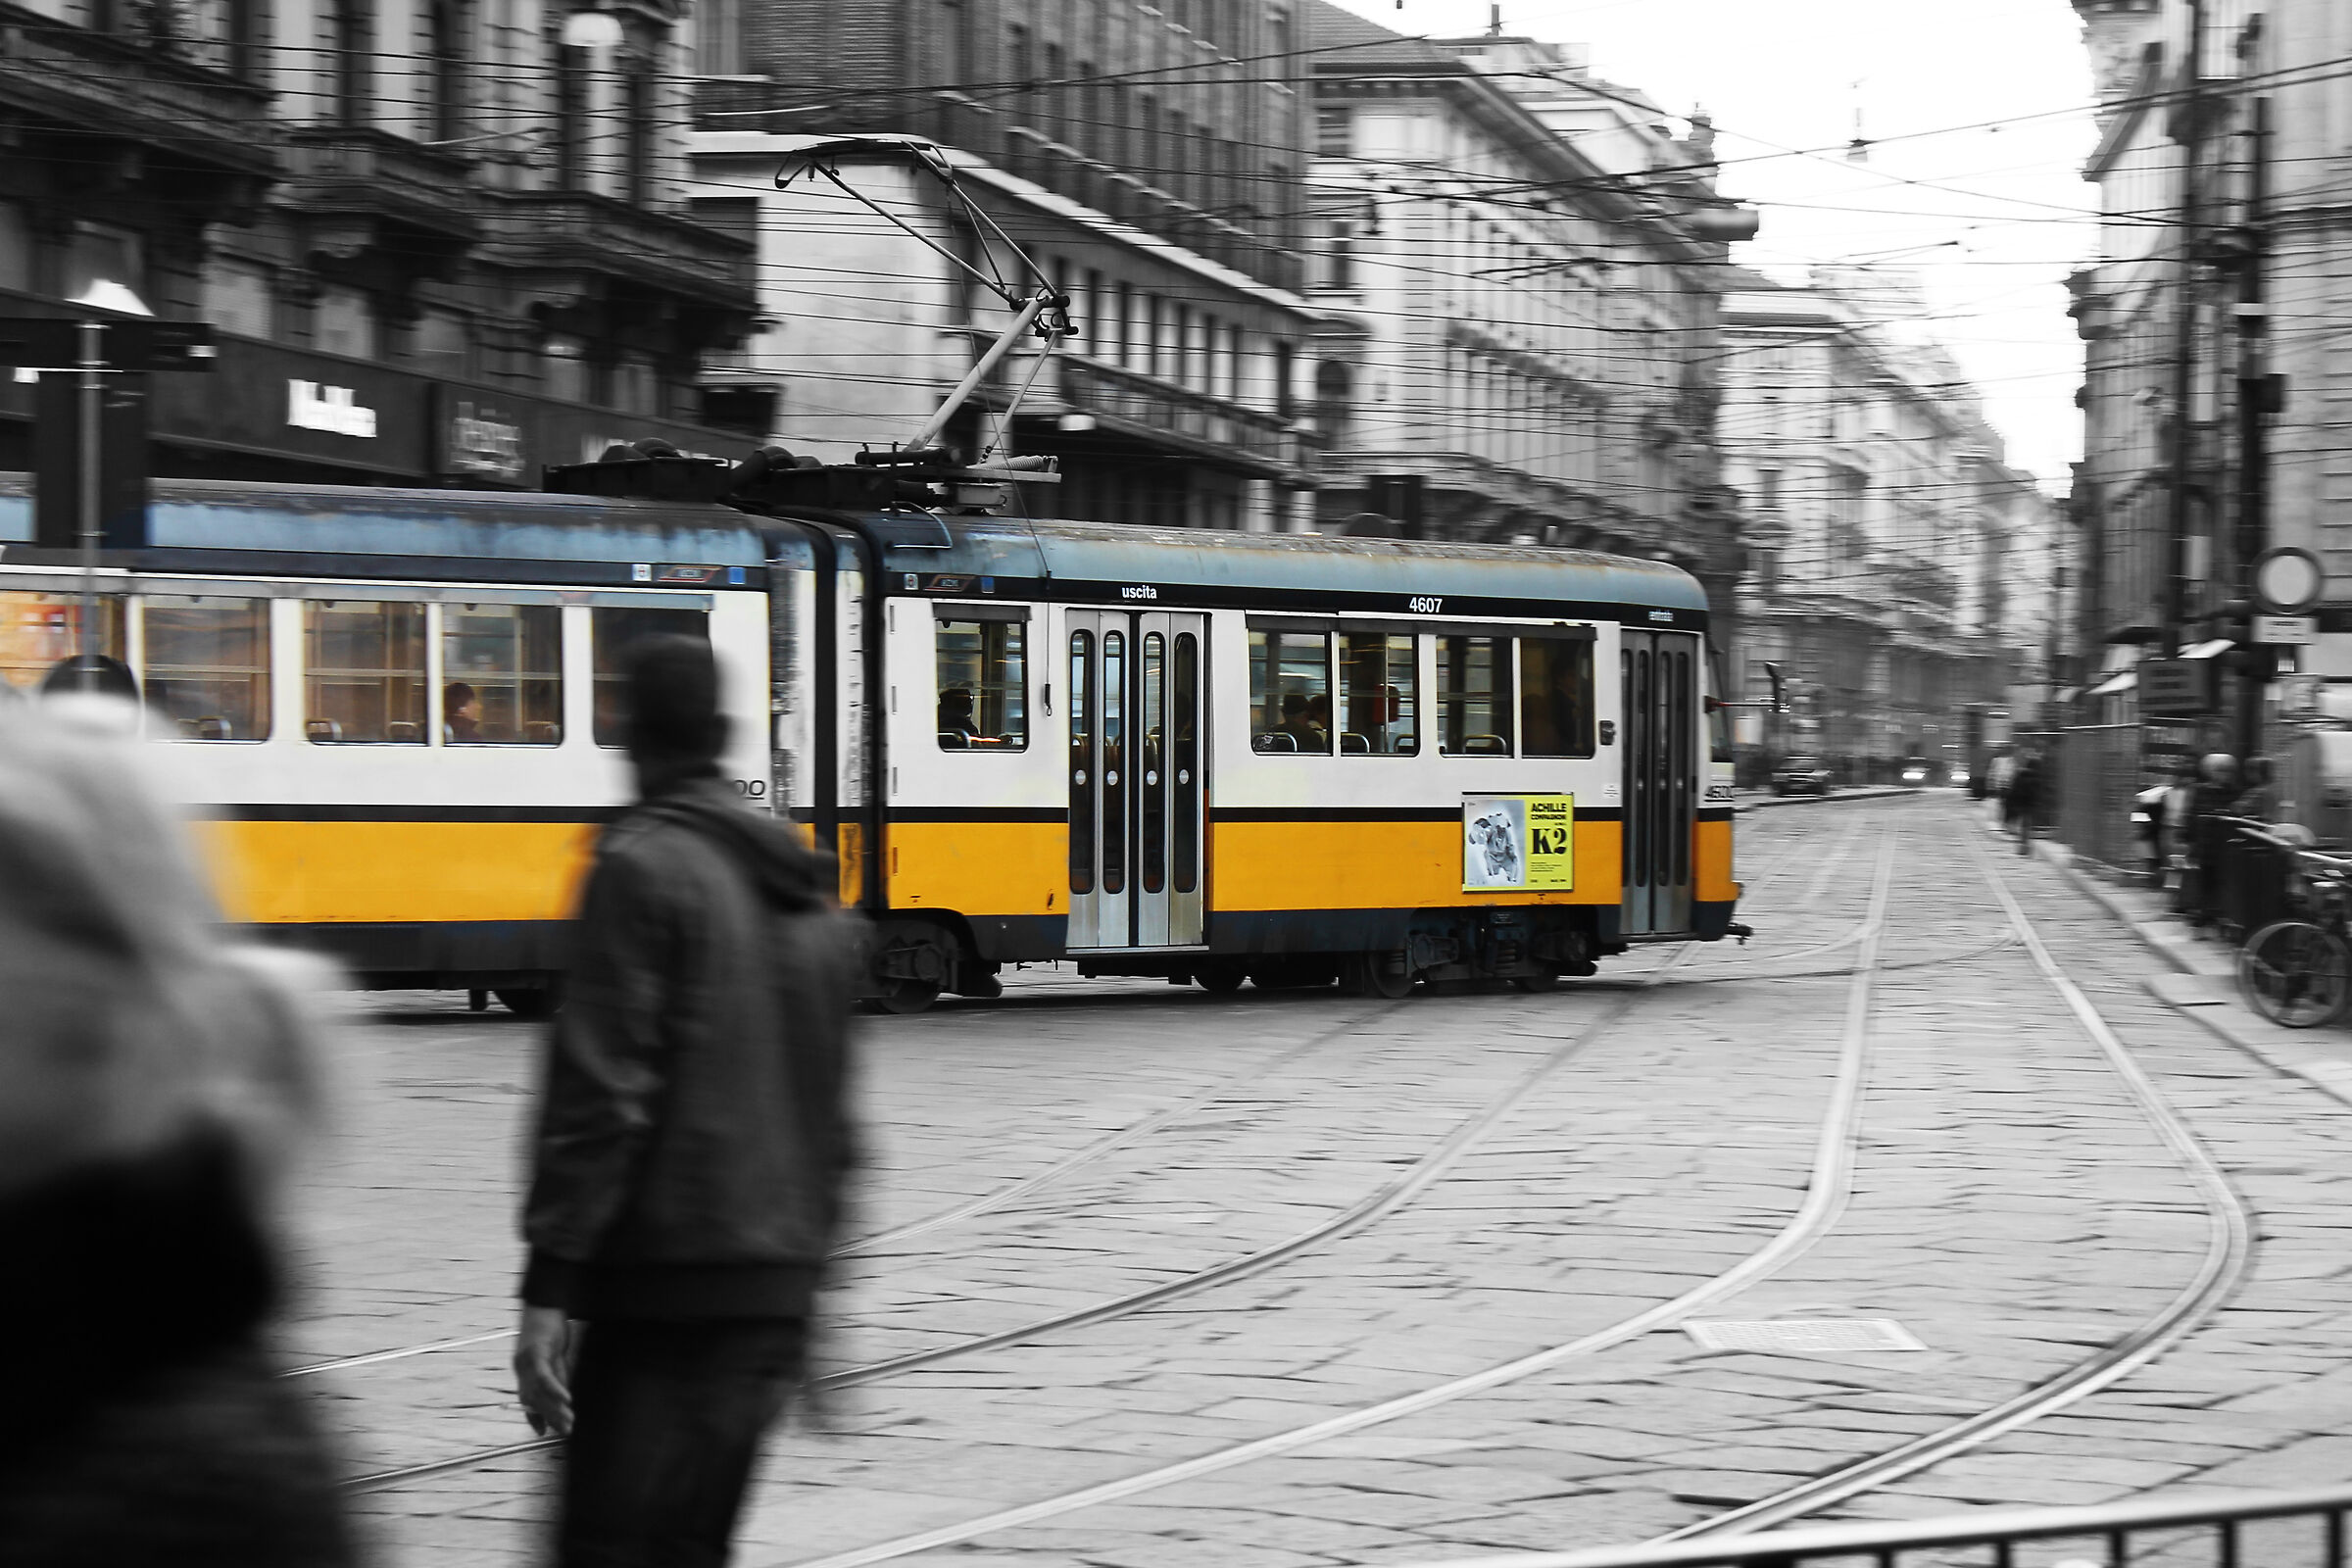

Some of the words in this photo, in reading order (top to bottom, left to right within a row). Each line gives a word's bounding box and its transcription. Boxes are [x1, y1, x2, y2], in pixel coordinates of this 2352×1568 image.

[1121, 584, 1157, 599] uscita
[1409, 597, 1443, 612] 4607
[1531, 803, 1567, 812] ACHILLE
[1530, 827, 1567, 855] K2
